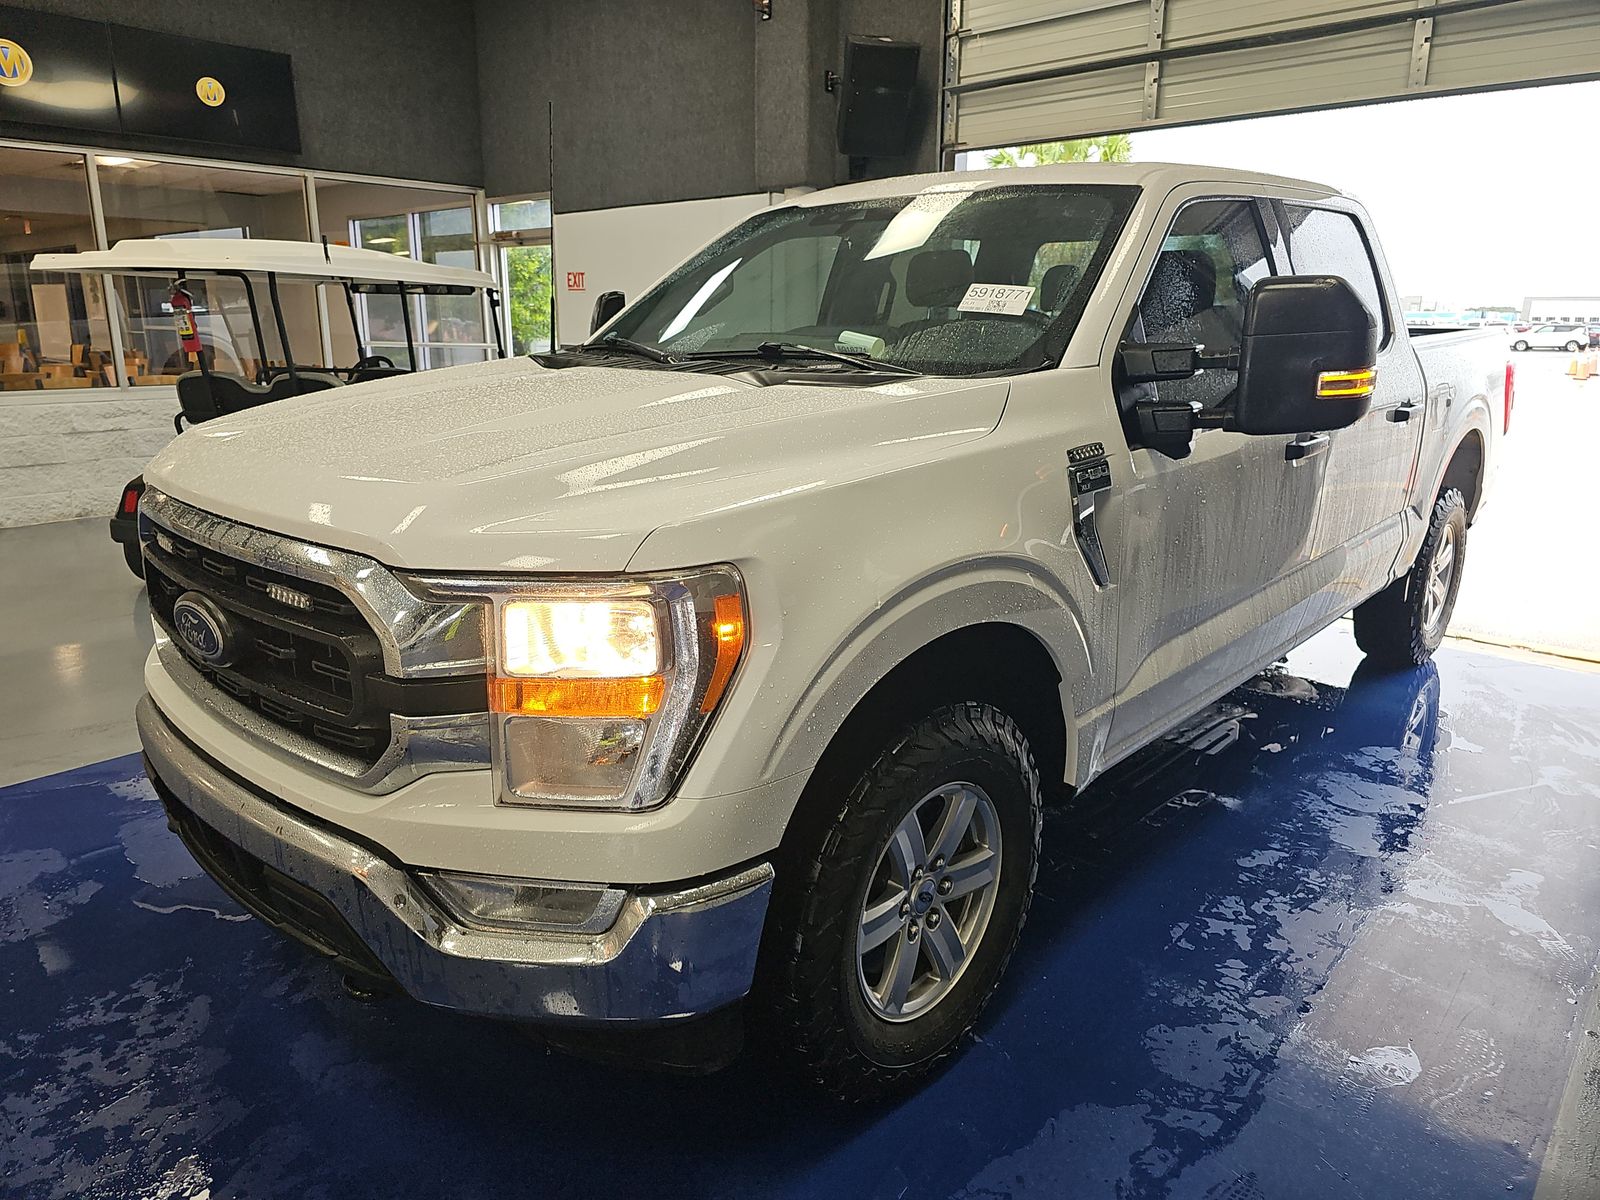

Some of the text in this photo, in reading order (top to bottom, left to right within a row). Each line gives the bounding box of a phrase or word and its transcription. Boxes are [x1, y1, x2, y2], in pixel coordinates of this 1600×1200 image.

[567, 271, 585, 288] EXIT
[968, 287, 1032, 301] 5918771
[180, 612, 207, 649] Ford
